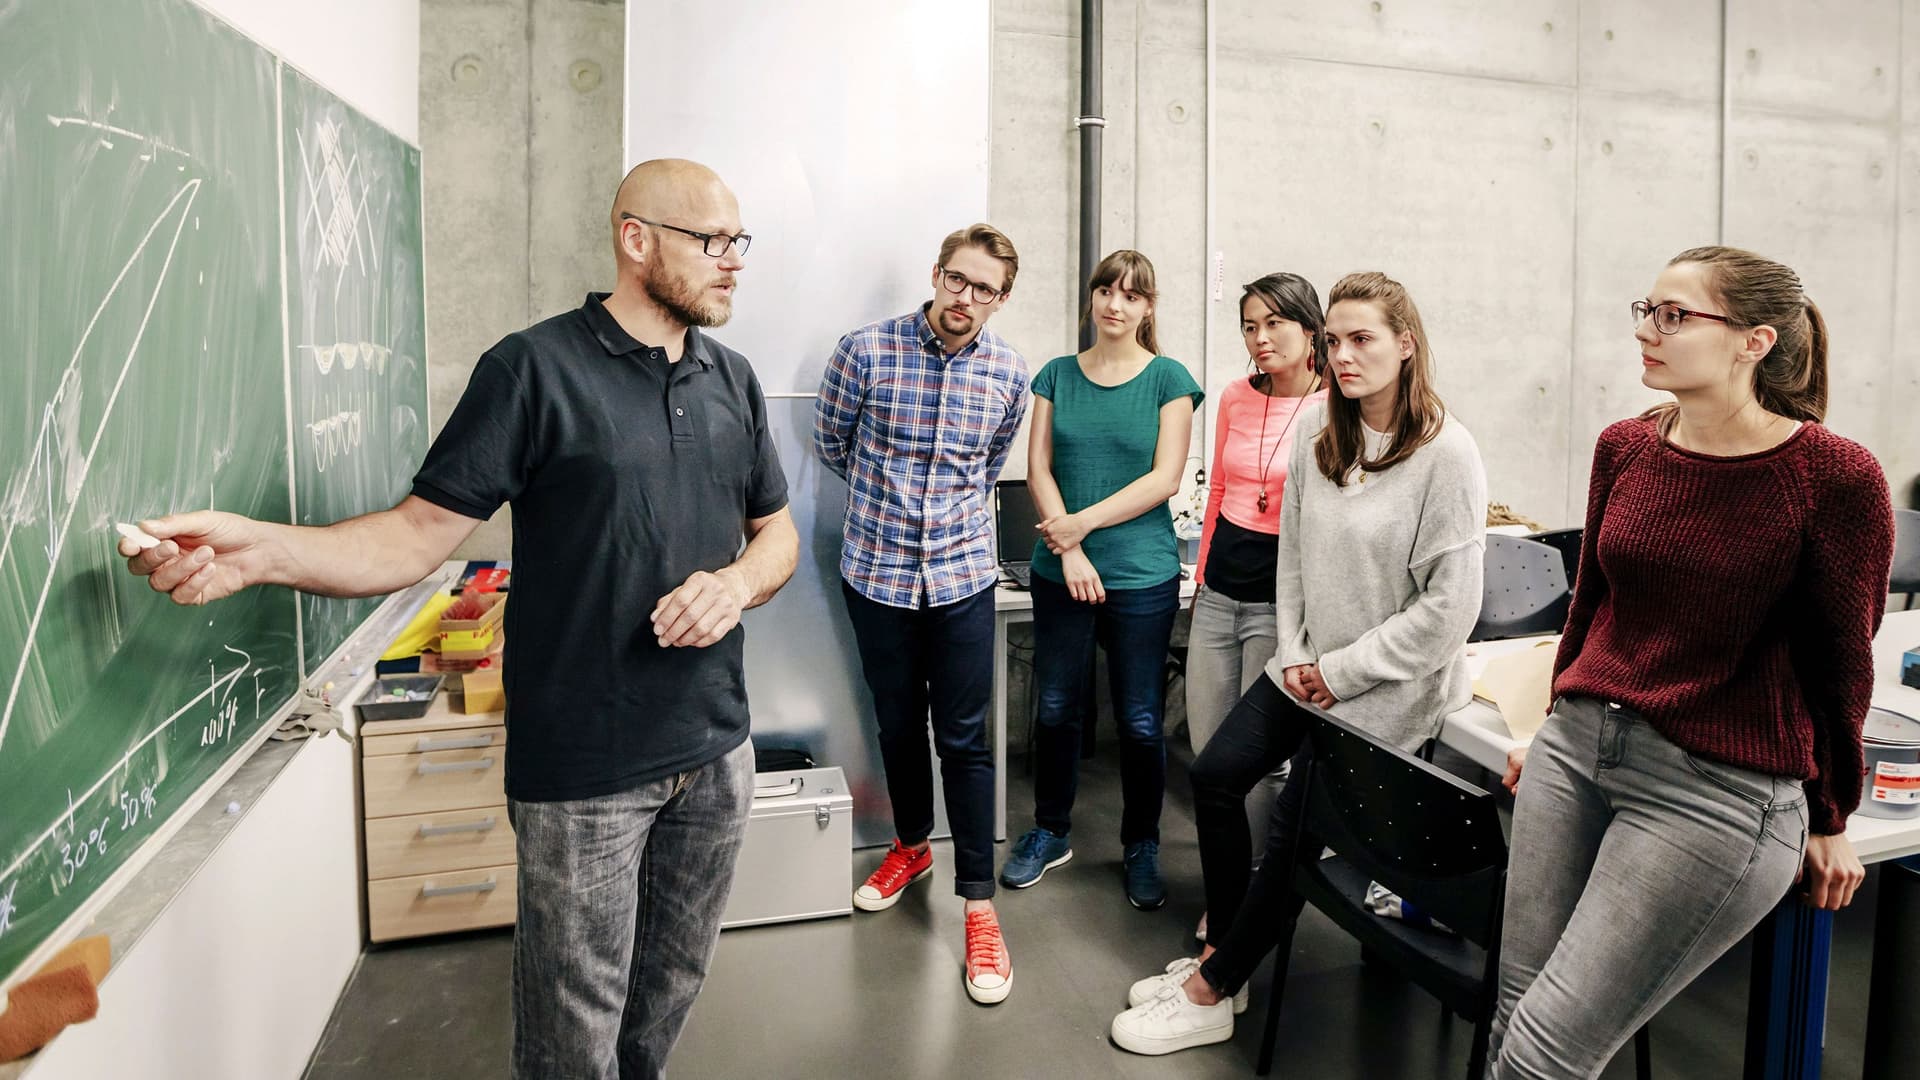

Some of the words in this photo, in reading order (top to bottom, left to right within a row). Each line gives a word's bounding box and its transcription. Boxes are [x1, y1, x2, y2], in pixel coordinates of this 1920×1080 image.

[200, 696, 239, 747] 100%
[120, 783, 158, 831] 50%
[60, 815, 110, 885] 30%
